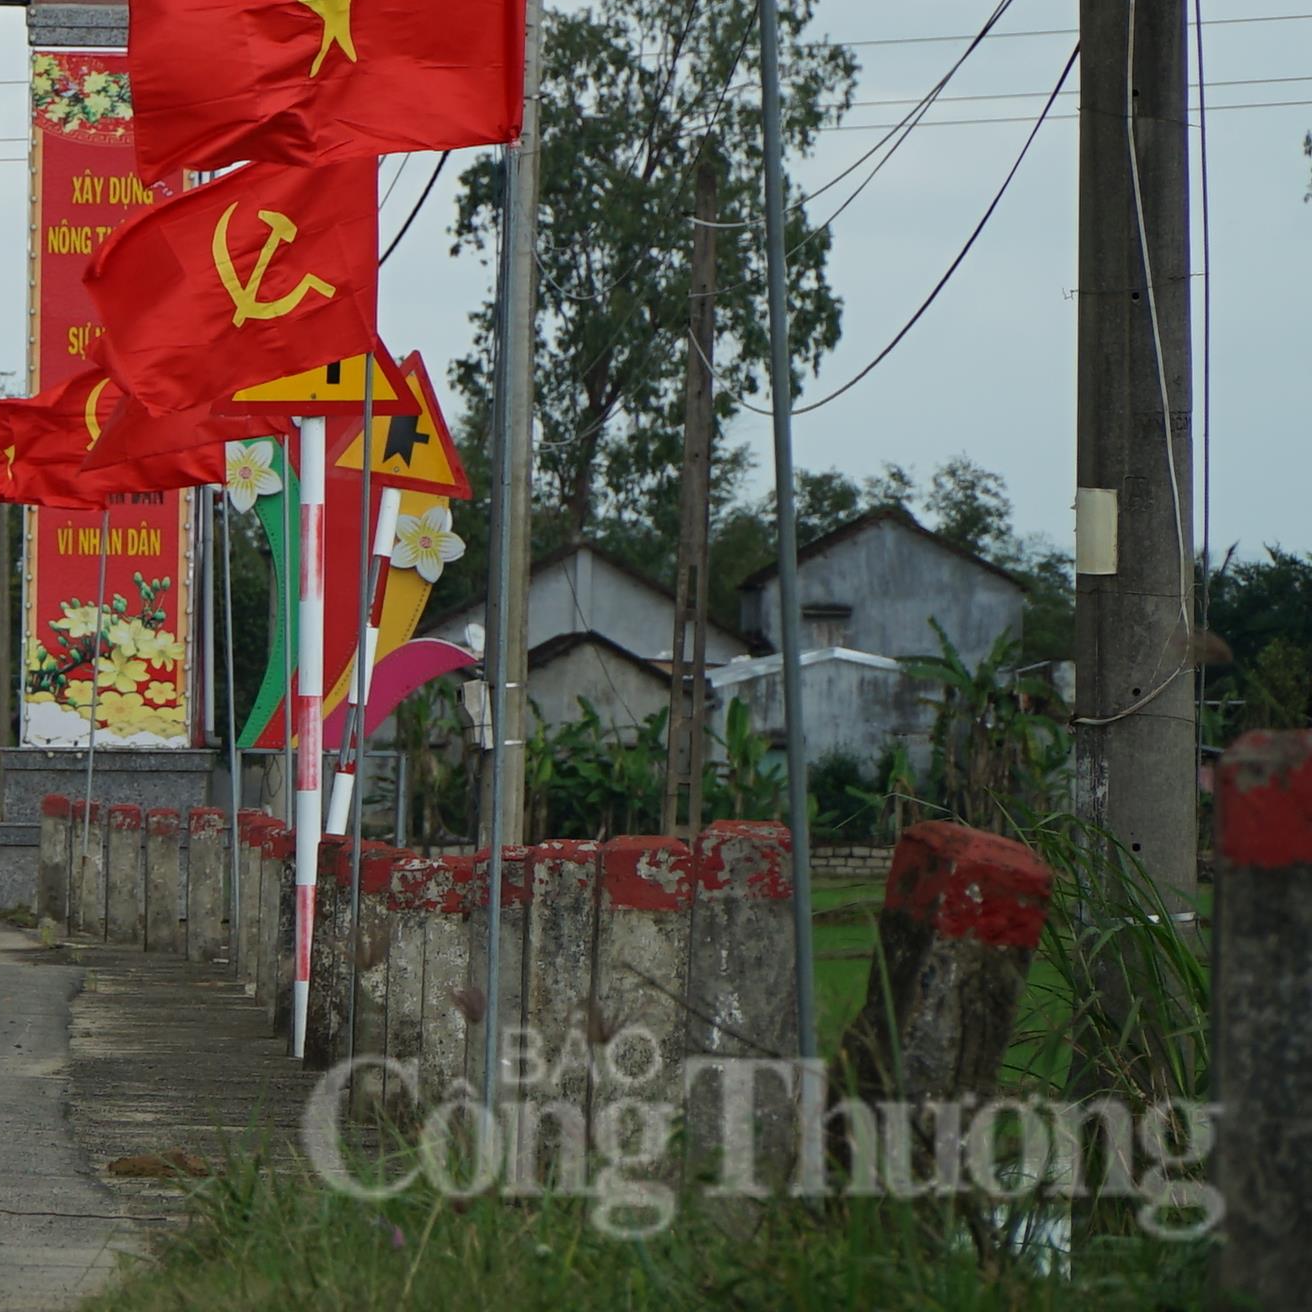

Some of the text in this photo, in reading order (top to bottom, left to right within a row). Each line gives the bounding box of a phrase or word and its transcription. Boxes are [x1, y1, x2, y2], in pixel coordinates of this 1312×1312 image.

[71, 169, 154, 210] XÂY DỰNG
[47, 218, 92, 255] NÔNG
[57, 520, 73, 555] VÌ
[127, 520, 161, 556] DÂN
